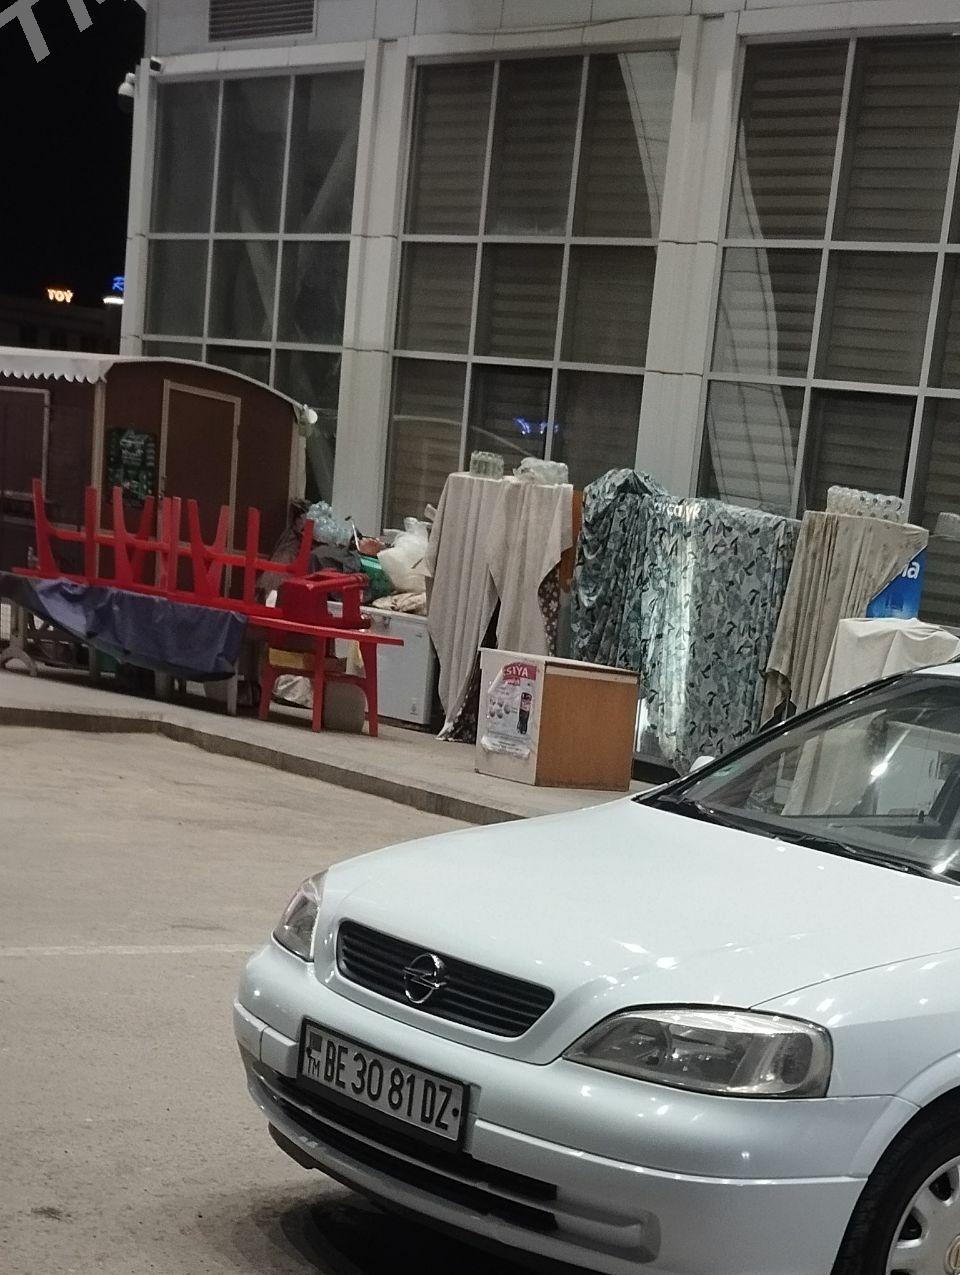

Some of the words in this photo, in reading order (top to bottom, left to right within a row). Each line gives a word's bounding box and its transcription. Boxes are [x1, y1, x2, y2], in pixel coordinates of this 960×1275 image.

[307, 1058, 320, 1078] TM
[324, 1040, 348, 1089] BE
[351, 1053, 384, 1101] 30
[388, 1067, 416, 1117] 81
[420, 1079, 452, 1131] DZ
